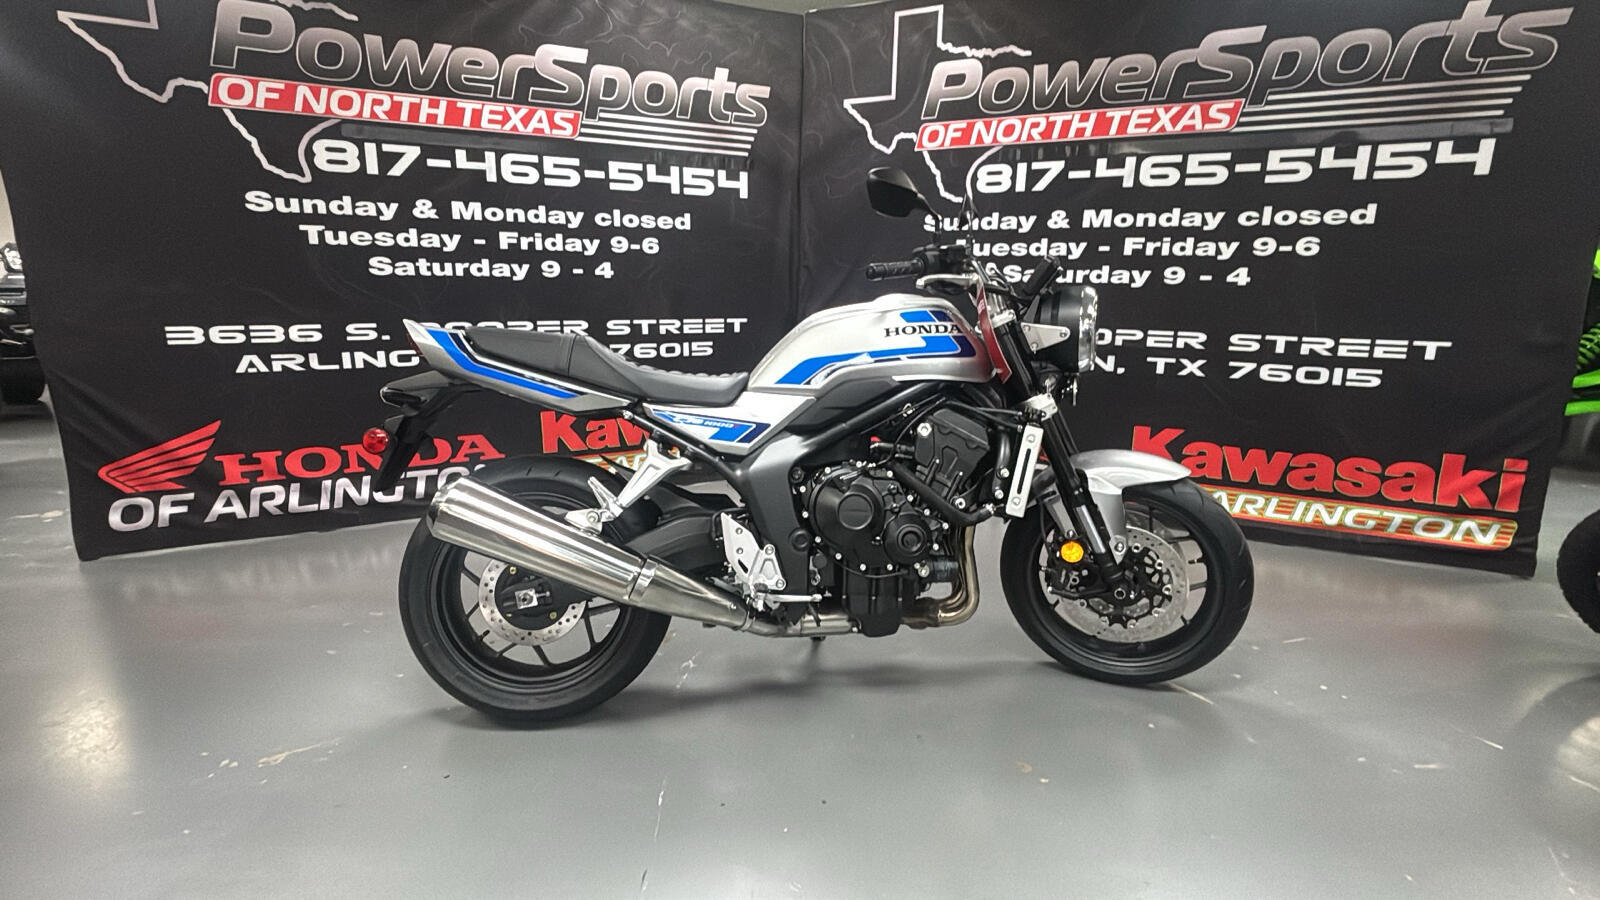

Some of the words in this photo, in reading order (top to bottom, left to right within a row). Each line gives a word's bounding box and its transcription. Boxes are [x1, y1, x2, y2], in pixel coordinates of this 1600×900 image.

[210, 0, 771, 127] PowerSports
[921, 0, 1574, 120] PowerSports
[218, 77, 285, 107] OF
[294, 84, 447, 125] NORTH
[457, 101, 575, 136] TEXAS
[922, 123, 962, 148] OF
[969, 111, 1099, 146] NORTH
[1106, 102, 1235, 134] TEXAS
[312, 138, 749, 199] 817-465-5454
[976, 138, 1496, 193] 817-465-5454
[244, 190, 399, 221] Sunday
[412, 199, 439, 219] &
[451, 201, 585, 228] Monday
[594, 209, 691, 230] closed
[1047, 209, 1070, 229] &
[1082, 208, 1225, 232] Monday
[1237, 203, 1378, 226] closed
[299, 224, 461, 252] Tuesday
[499, 231, 600, 256] Friday
[610, 236, 660, 254] 9-6
[1123, 237, 1240, 260] Friday
[1252, 236, 1321, 257] 9-6
[368, 256, 530, 281] Saturday
[541, 261, 561, 278] 9
[594, 262, 614, 279] 4
[1003, 264, 1153, 288] Surday
[1163, 266, 1186, 285] 9
[1226, 267, 1251, 286] 4
[164, 324, 323, 345] 3636
[345, 323, 391, 341] S.
[606, 318, 748, 336] STREET
[884, 323, 963, 338] HONDA
[1096, 328, 1207, 349] OPER
[1228, 333, 1453, 361] STREET
[609, 341, 714, 359] 76015
[1147, 357, 1207, 378] TX
[1228, 361, 1383, 388] 76015
[1132, 425, 1529, 513] Kawasaki
[108, 493, 195, 531] OF
